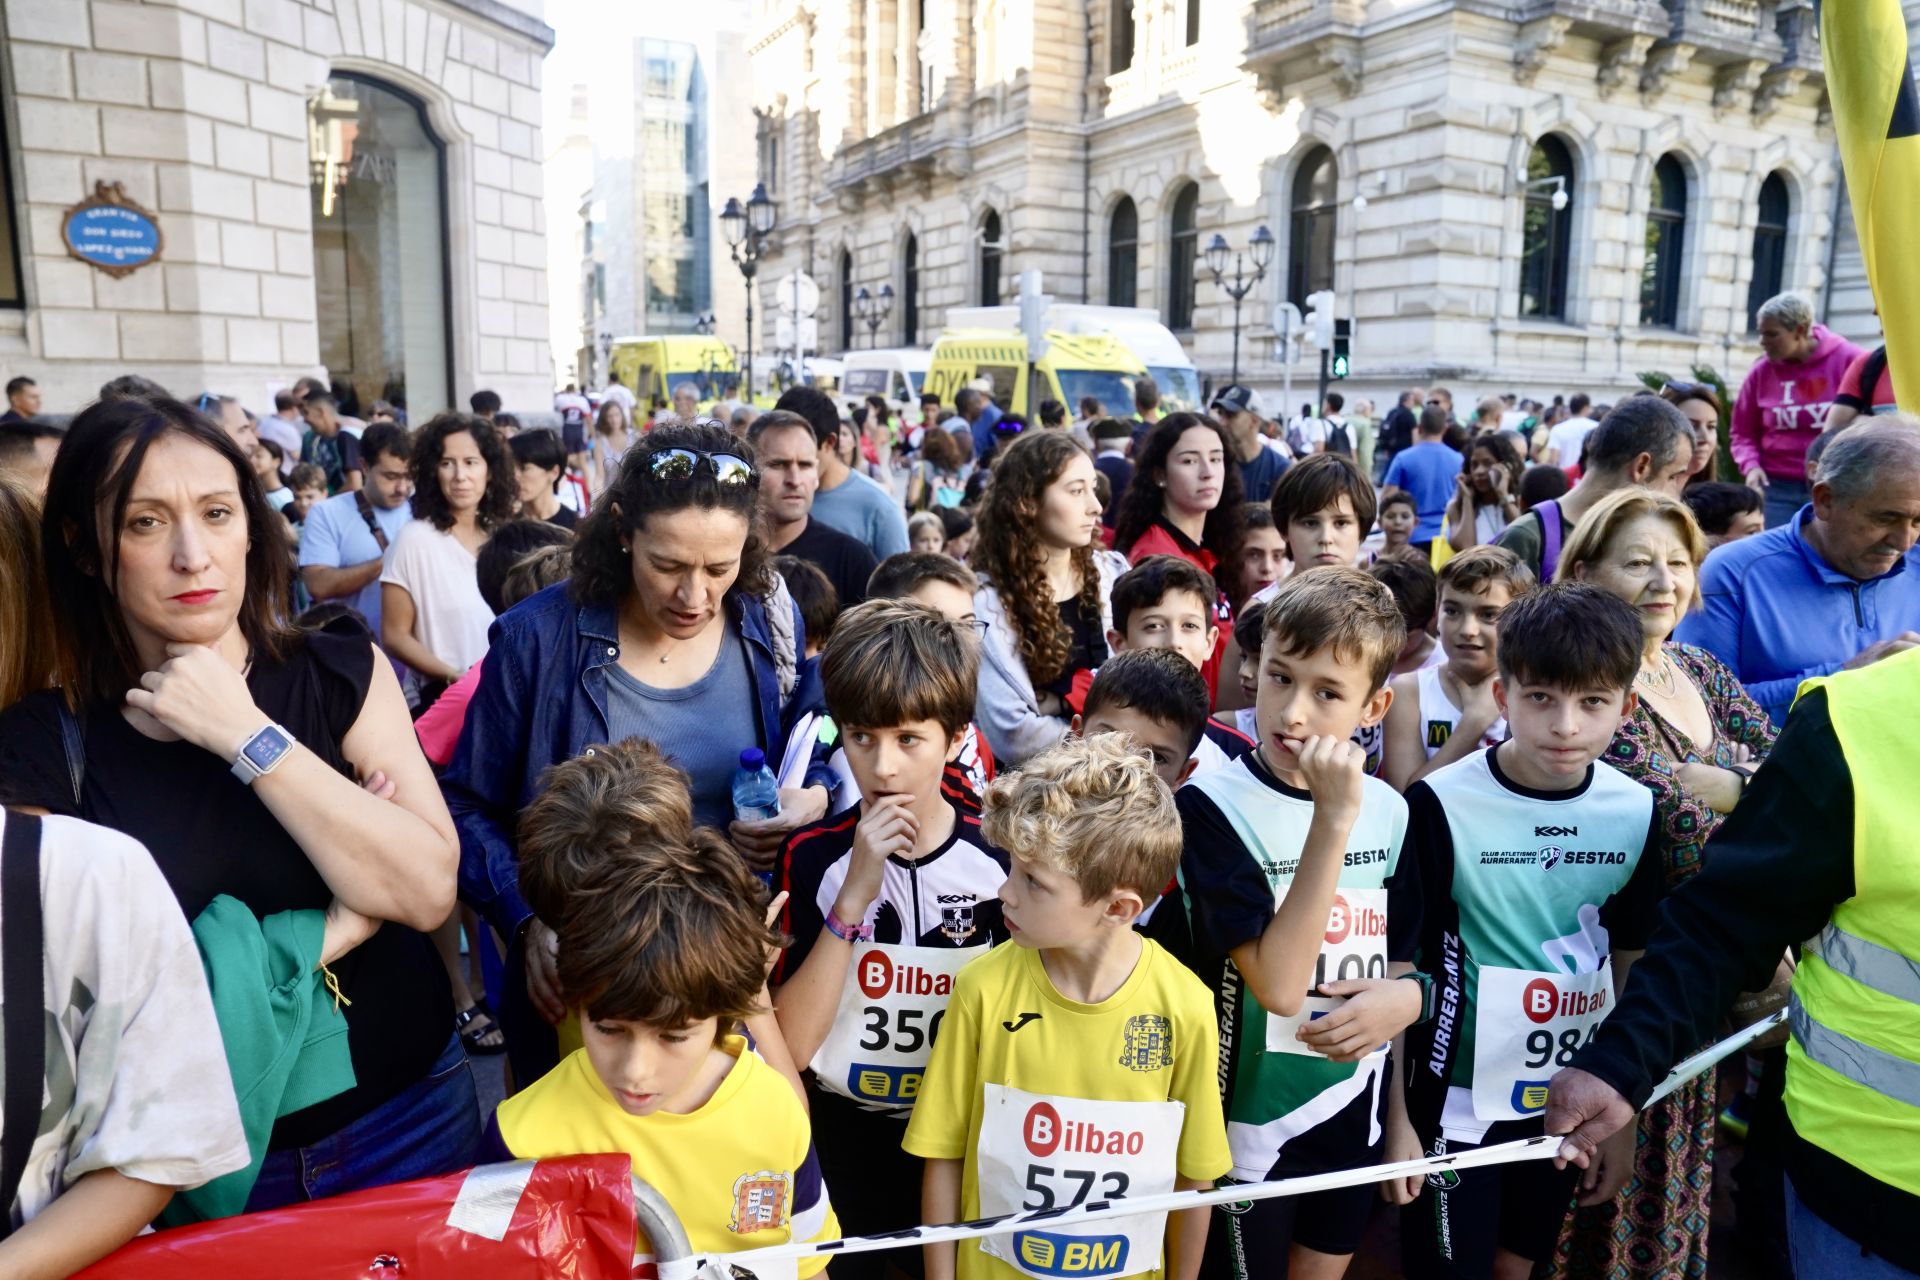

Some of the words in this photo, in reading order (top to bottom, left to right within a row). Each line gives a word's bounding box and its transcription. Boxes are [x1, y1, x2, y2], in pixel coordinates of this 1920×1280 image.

[83, 227, 107, 236] DON
[1780, 381, 1795, 405] I
[1773, 402, 1832, 430] NY
[1264, 866, 1297, 876] URRER
[1279, 858, 1300, 867] ATLET
[1563, 851, 1626, 865] SESTAO
[1324, 903, 1387, 938] Bilba
[862, 956, 957, 997] Bilba
[1429, 931, 1459, 1079] AURRERANTZ
[1529, 984, 1606, 1017] Bilbao
[1217, 957, 1239, 1101] URRERANTZ
[1028, 1108, 1144, 1156] Bilbao
[1023, 1164, 1130, 1211] 573
[1061, 1241, 1121, 1271] BM
